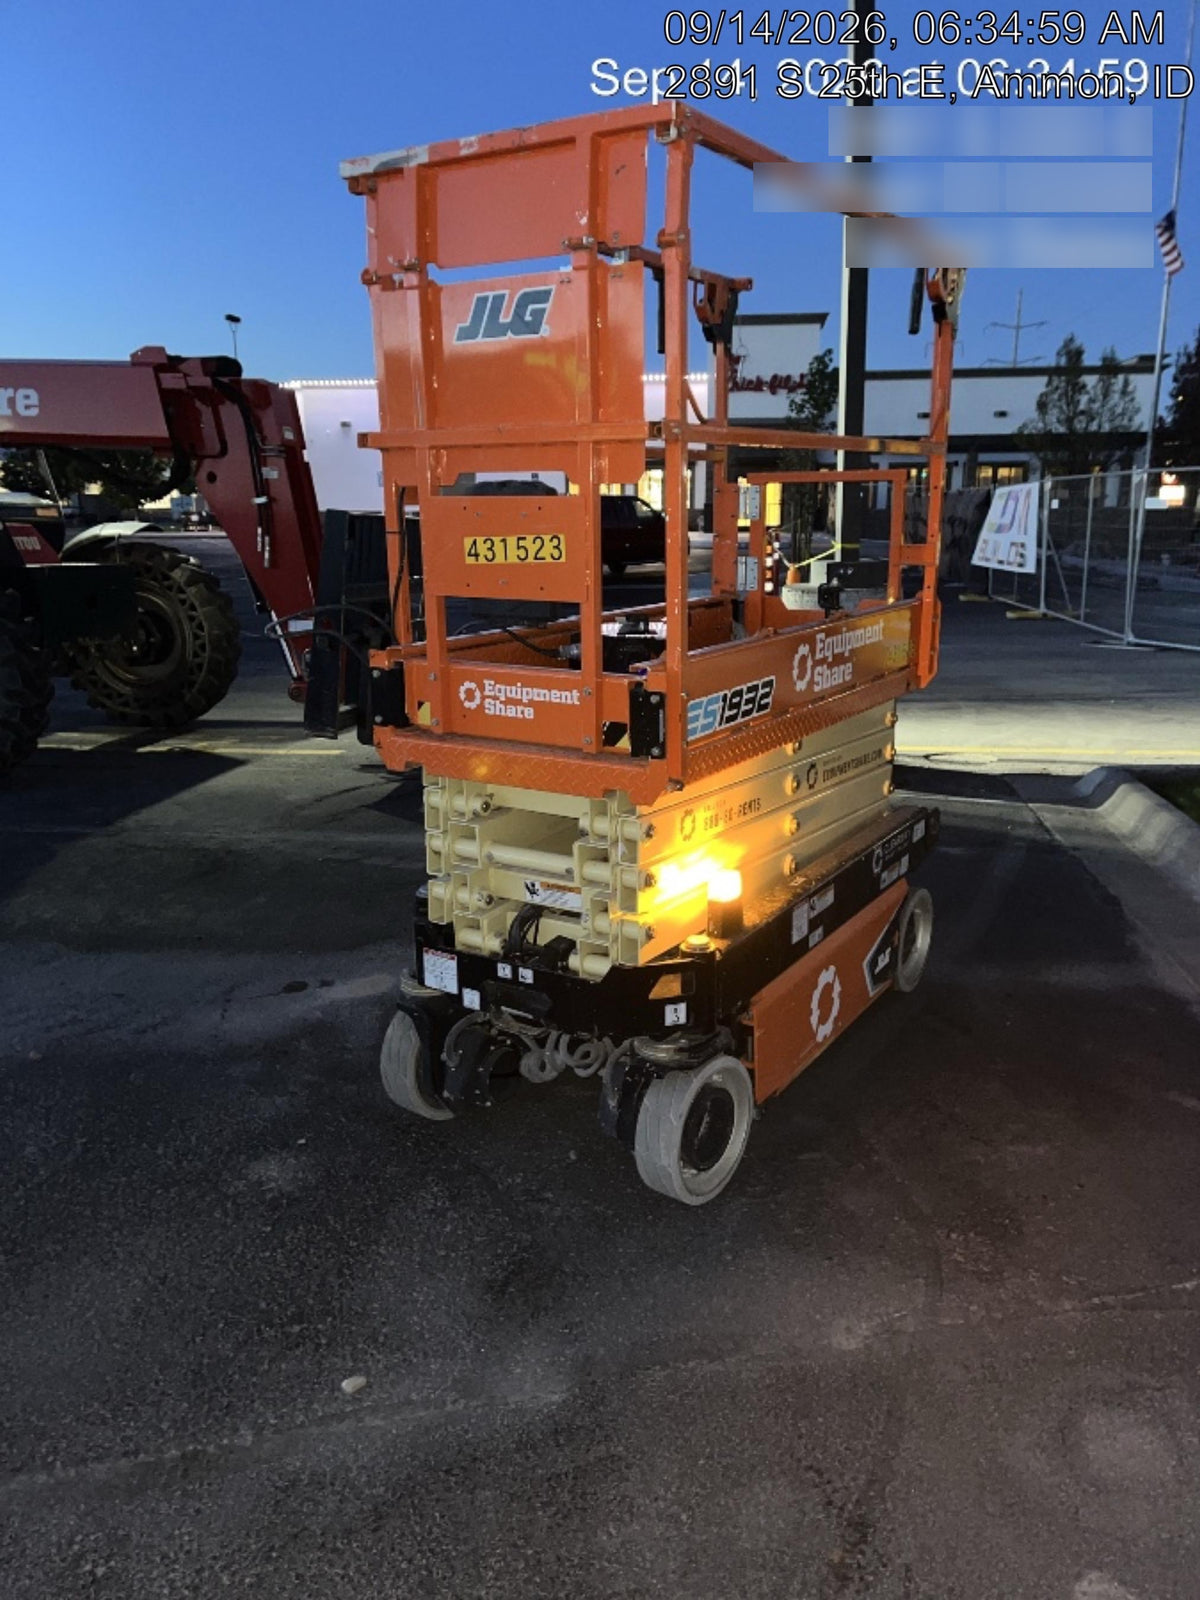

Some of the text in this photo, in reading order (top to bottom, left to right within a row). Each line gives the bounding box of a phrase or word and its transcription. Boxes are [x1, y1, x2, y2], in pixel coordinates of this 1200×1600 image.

[454, 284, 555, 344] JLG
[466, 534, 564, 563] 431523
[815, 620, 884, 662] Equipment
[813, 662, 852, 692] Share
[483, 679, 581, 705] Equipment
[484, 698, 534, 719] Share
